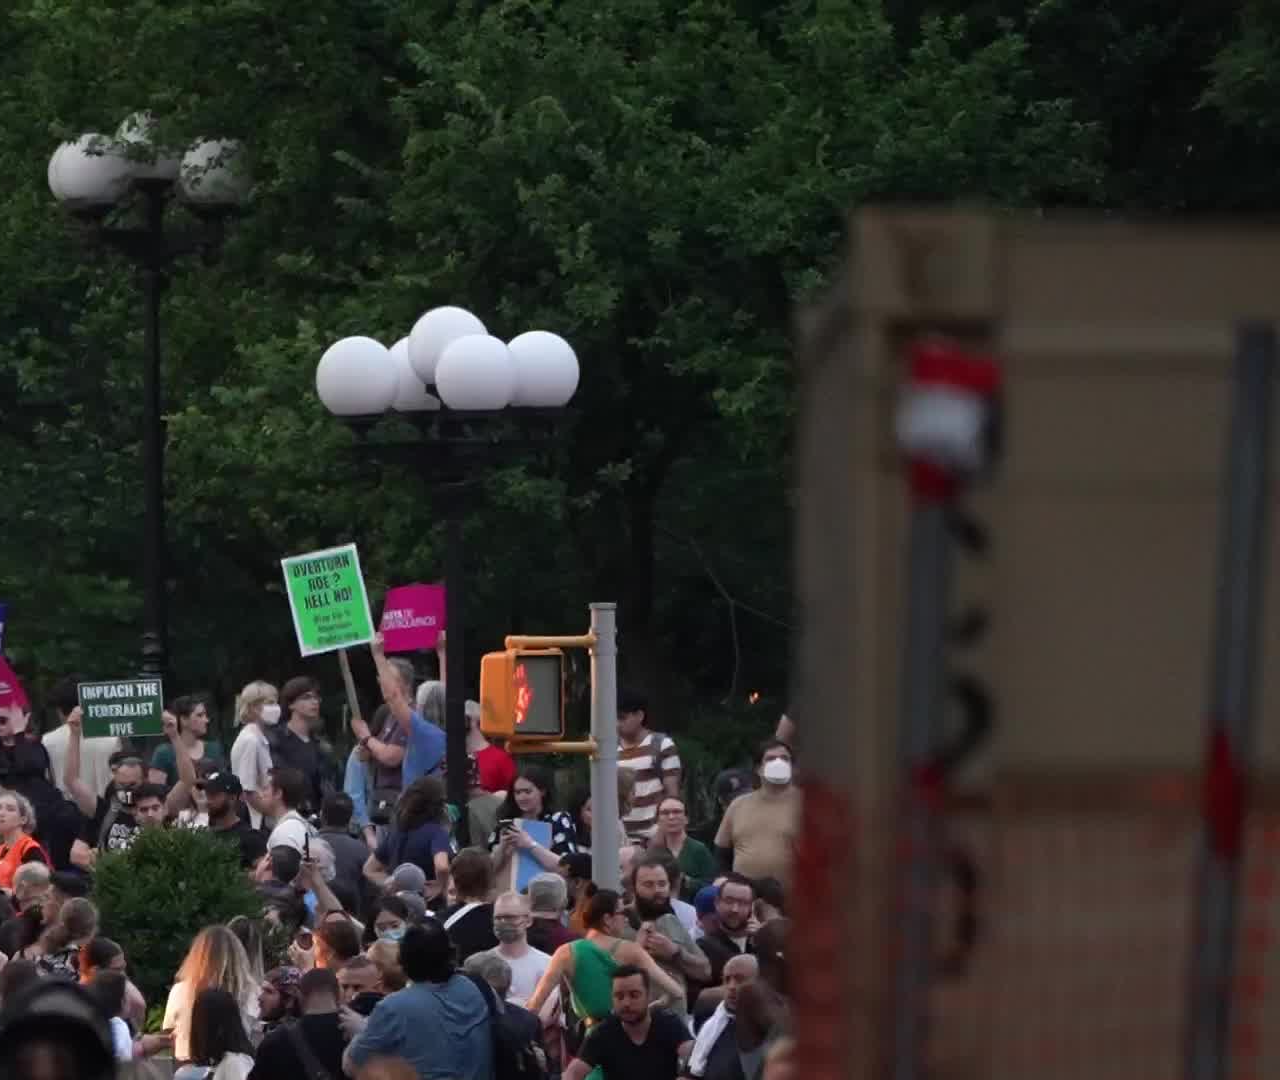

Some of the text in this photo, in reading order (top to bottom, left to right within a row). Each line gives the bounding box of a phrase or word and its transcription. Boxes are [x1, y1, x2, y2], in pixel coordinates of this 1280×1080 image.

[293, 552, 351, 578] OVERTURN
[308, 577, 330, 593] ROE
[304, 585, 353, 609] HELL NO!
[82, 682, 159, 700] IMPEACH THE
[88, 702, 154, 718] FEDERALIST
[109, 722, 135, 737] FIVE
